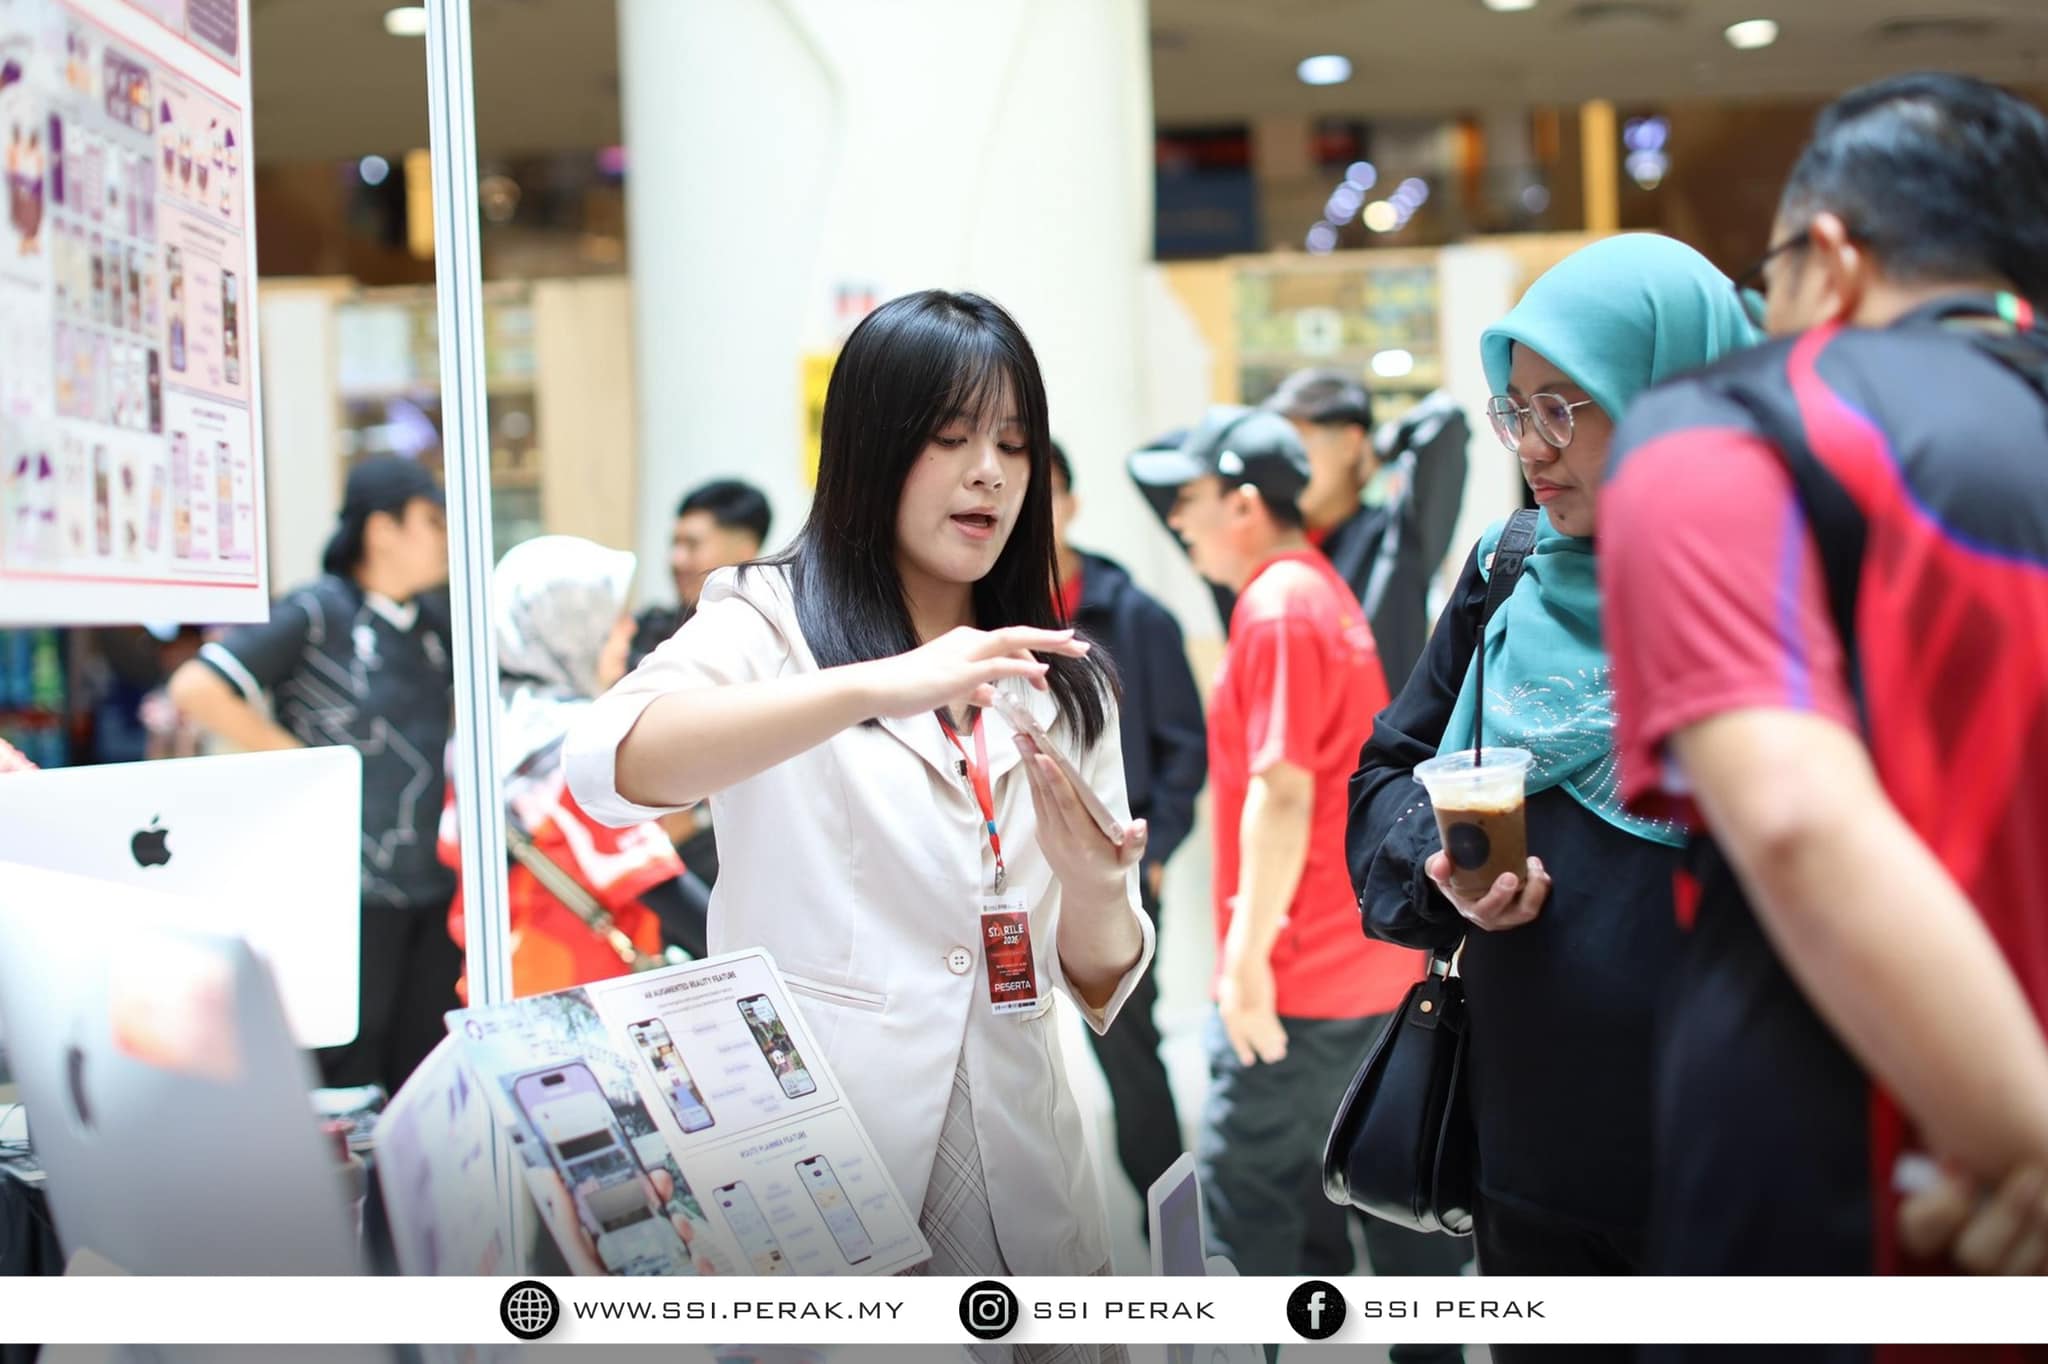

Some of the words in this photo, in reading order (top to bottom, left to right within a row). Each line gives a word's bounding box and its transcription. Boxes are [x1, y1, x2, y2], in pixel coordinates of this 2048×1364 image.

[689, 977, 711, 988] REALITY
[712, 971, 736, 983] FEATURE
[994, 981, 1031, 992] PESERTA
